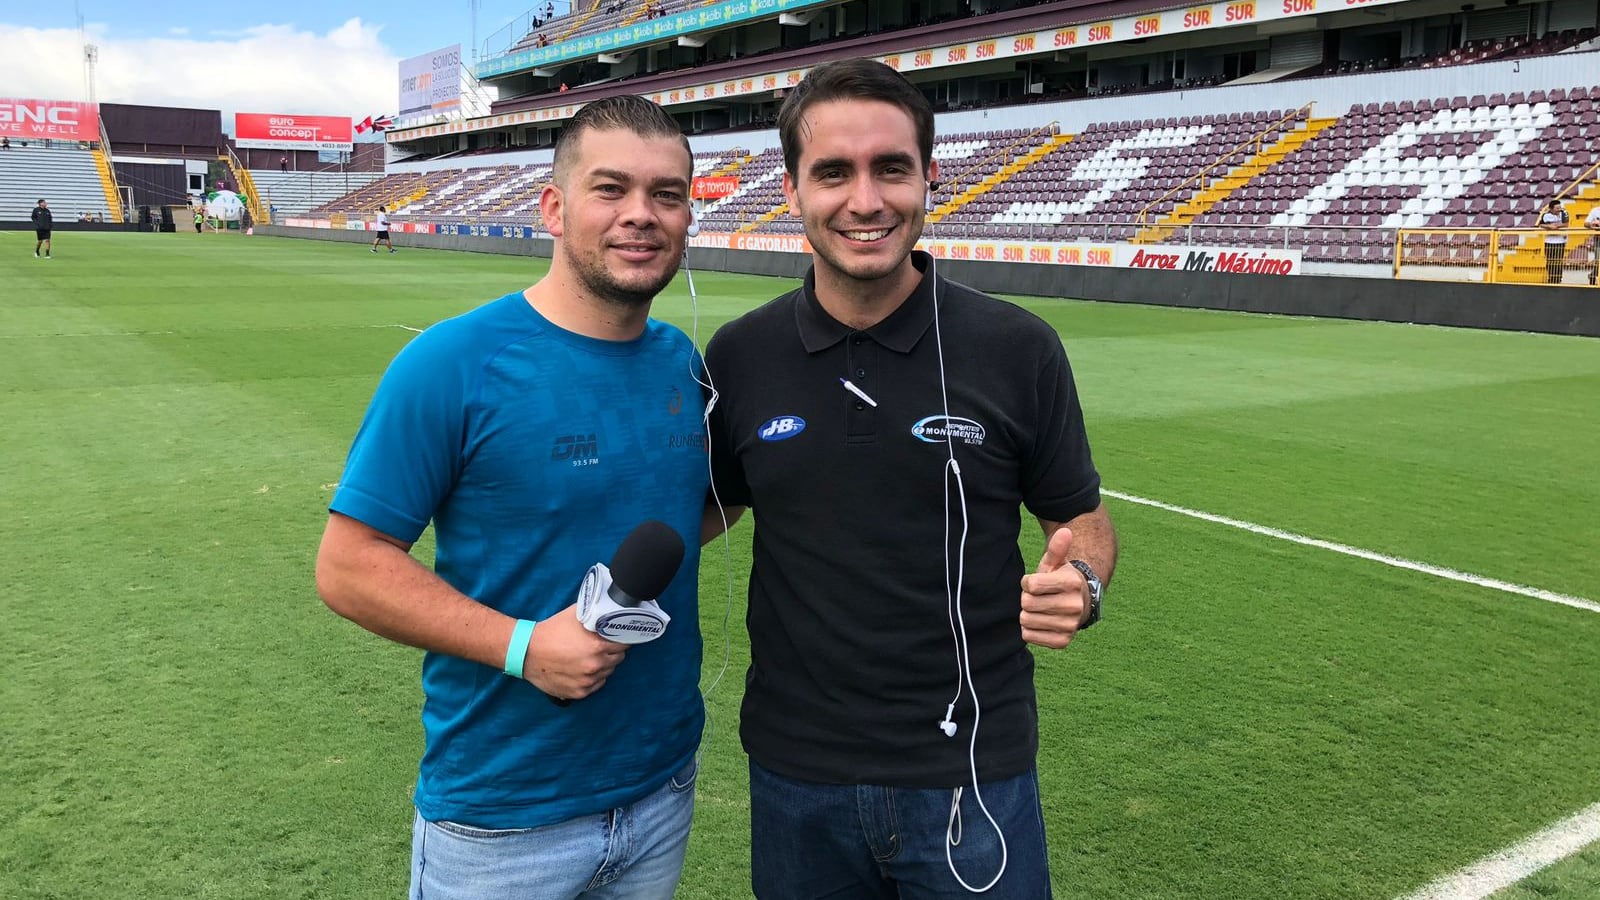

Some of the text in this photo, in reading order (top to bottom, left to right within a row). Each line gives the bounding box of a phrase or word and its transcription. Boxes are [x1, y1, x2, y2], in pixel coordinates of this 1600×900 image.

[914, 53, 931, 67] SUR
[948, 47, 966, 62] SUR
[976, 43, 995, 58] SUR
[1014, 37, 1034, 53] SUR
[1054, 30, 1076, 47] SUR
[1088, 25, 1112, 42] SUR
[1134, 18, 1159, 36] SUR
[1183, 10, 1209, 28] SUR
[1225, 3, 1253, 22] SUR
[1283, 0, 1314, 14] SUR
[432, 51, 459, 70] SOMOS
[269, 117, 295, 127] euro
[31, 124, 79, 135] WELL
[706, 181, 736, 194] TOYOTA
[745, 237, 804, 251] GATORADE
[928, 245, 947, 259] SUR
[951, 245, 970, 259] SUR
[975, 246, 995, 260] SUR
[1003, 247, 1024, 261] SUR
[1030, 247, 1052, 262] SUR
[1057, 248, 1081, 264] SUR
[1087, 249, 1111, 265] SUR
[1129, 249, 1180, 270] Arroz
[925, 427, 984, 440] MONUMENTAL
[607, 623, 661, 634] MONUMENTAL
